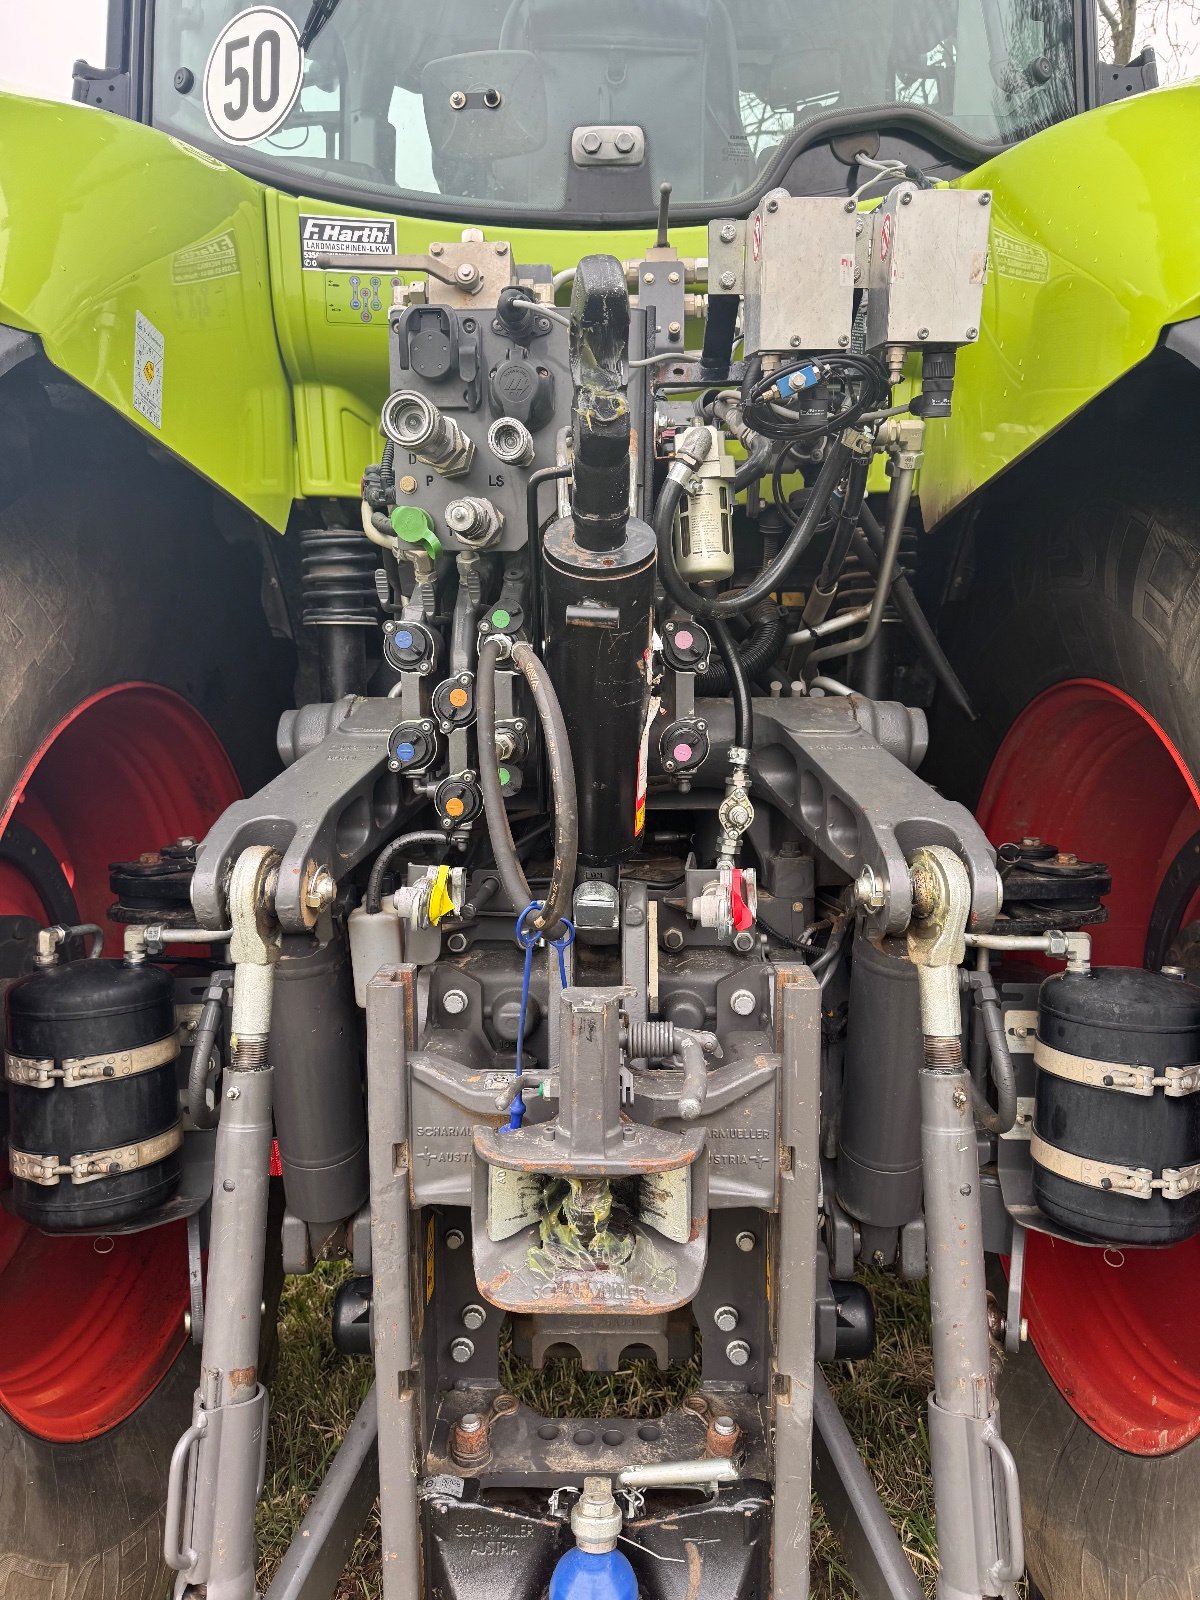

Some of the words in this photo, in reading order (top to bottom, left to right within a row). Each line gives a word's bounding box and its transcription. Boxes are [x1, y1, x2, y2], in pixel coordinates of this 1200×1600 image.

[223, 30, 280, 120] 50
[427, 475, 434, 486] P
[489, 475, 505, 487] LS
[416, 1126, 472, 1137] SCHARM
[439, 1151, 472, 1163] AUST
[471, 1541, 520, 1556] AUSTRIA
